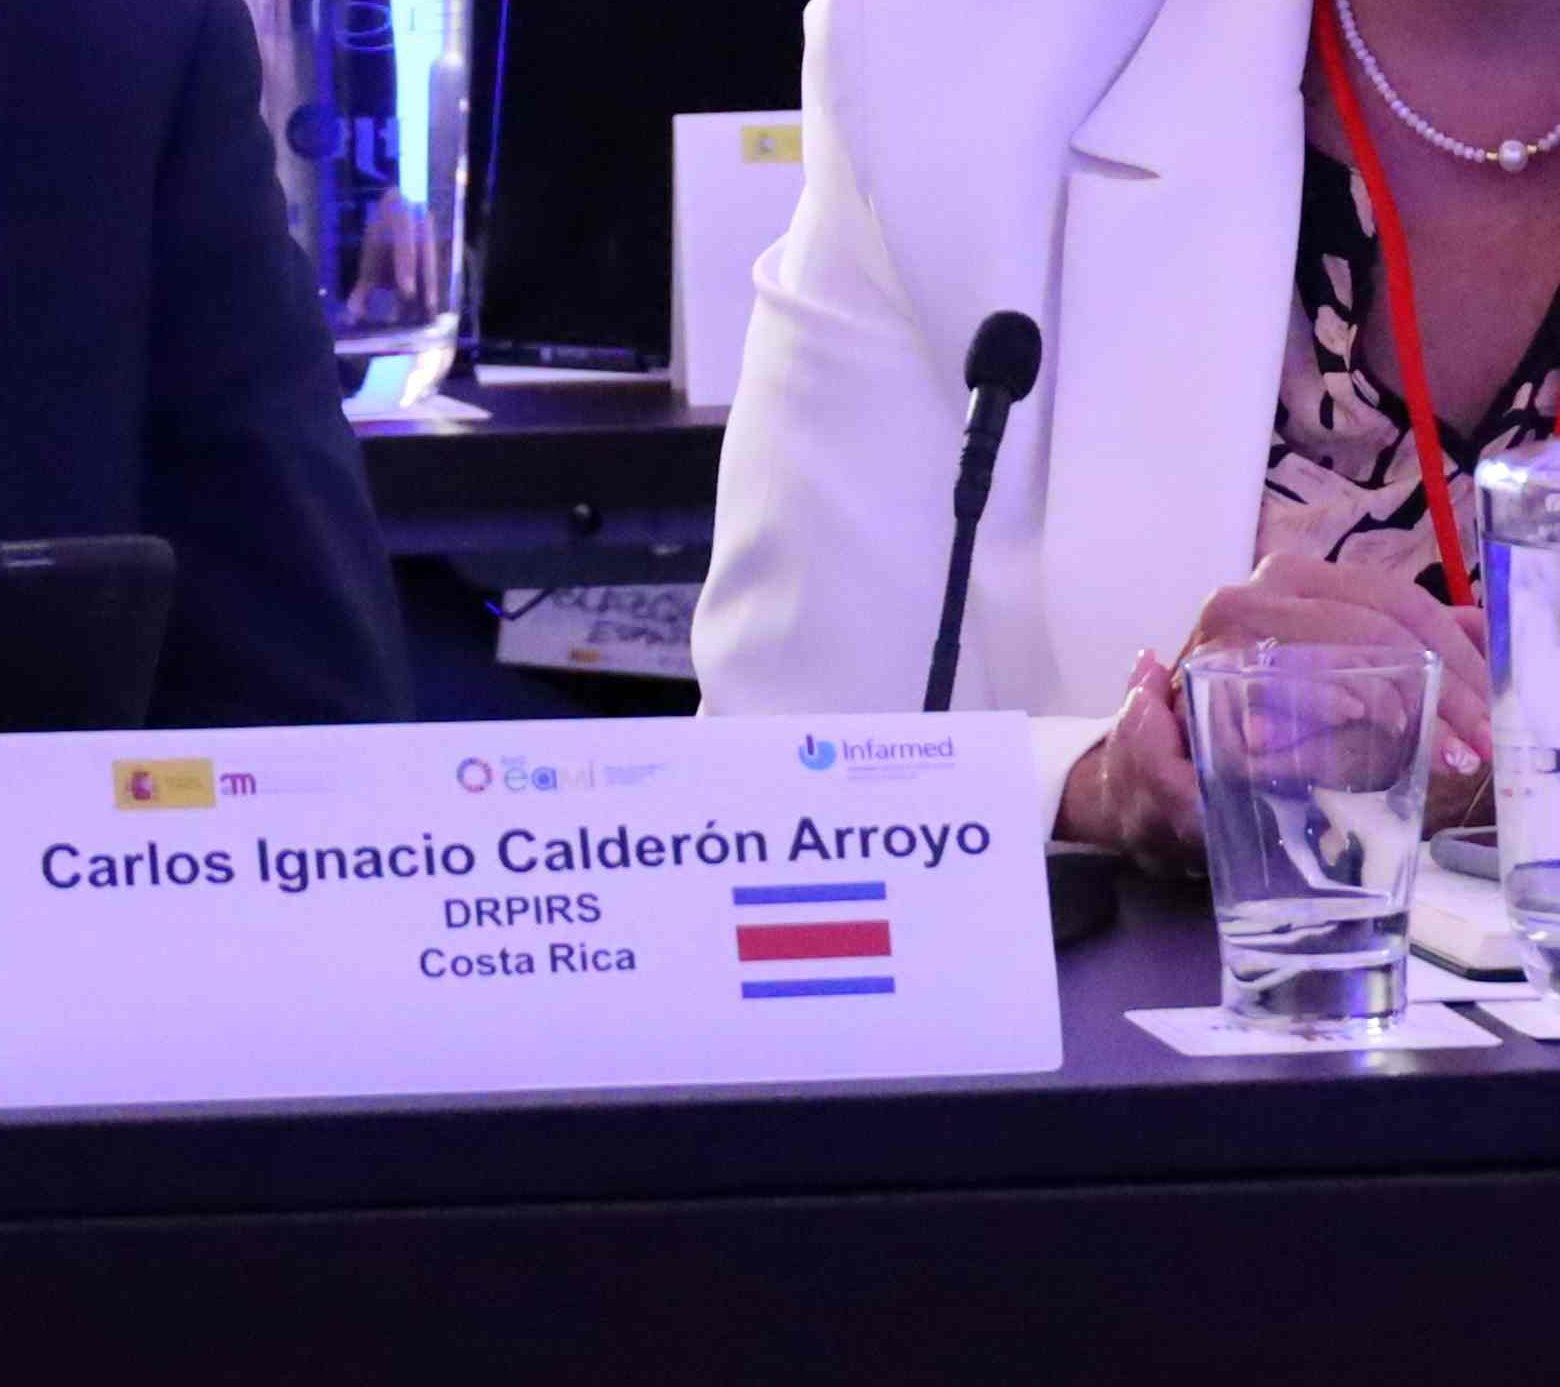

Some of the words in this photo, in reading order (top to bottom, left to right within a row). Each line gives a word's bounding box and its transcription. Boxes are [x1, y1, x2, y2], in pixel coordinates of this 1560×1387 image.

[842, 735, 956, 761] Infarmed
[41, 842, 235, 890] Carlos
[257, 834, 476, 893] Ignacio
[497, 820, 768, 874] Calderón
[787, 816, 991, 869] Arroyo
[444, 893, 602, 929] DRPIRS
[419, 947, 535, 979] Costa
[548, 943, 636, 974] Rica
